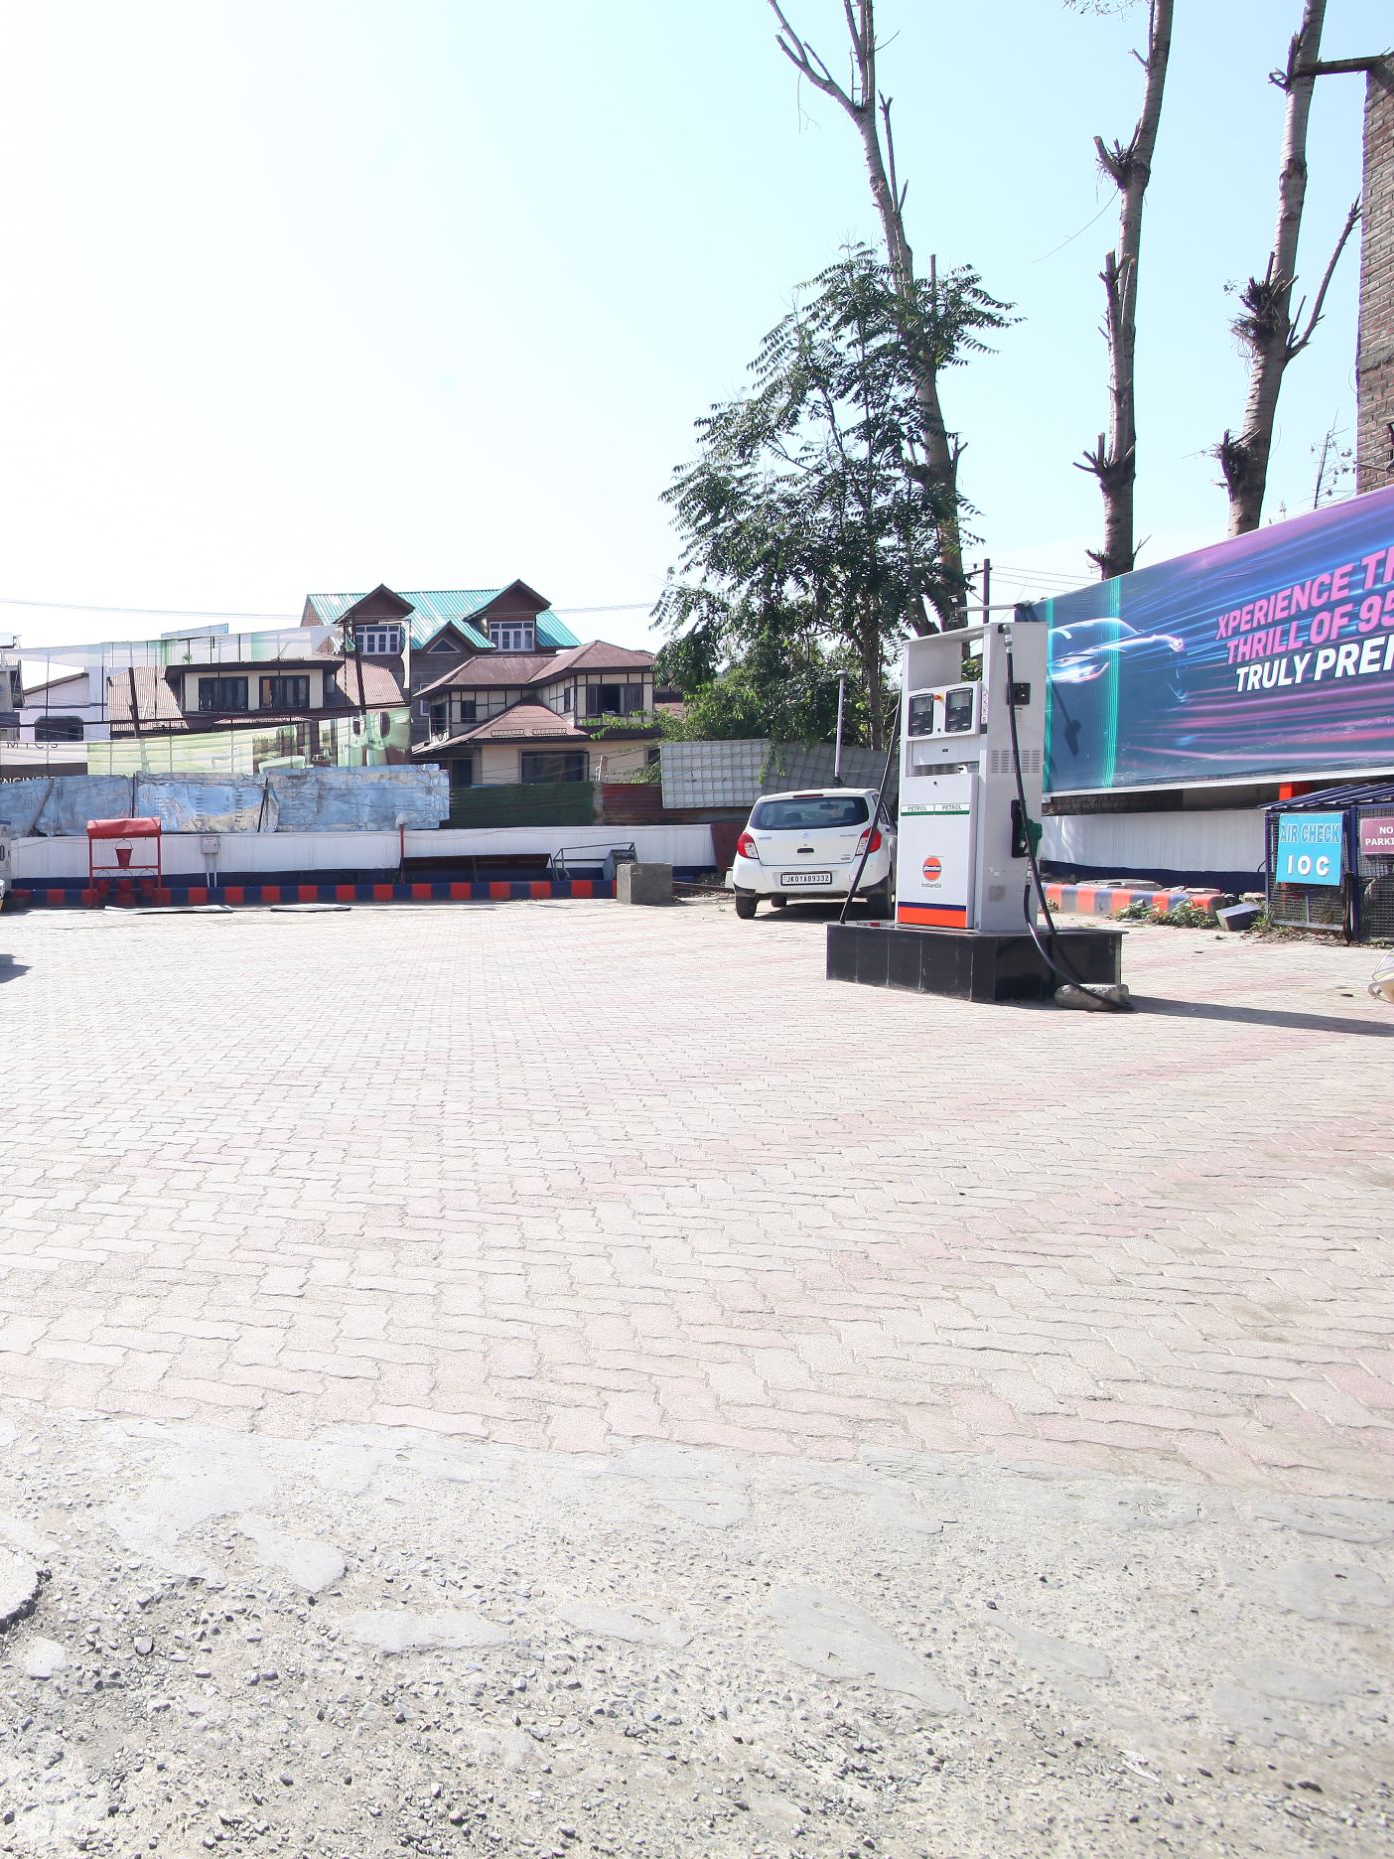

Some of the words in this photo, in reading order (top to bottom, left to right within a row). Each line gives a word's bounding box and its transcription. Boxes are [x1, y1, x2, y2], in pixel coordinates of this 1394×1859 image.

[1215, 563, 1354, 641] XPERIENCE
[1226, 620, 1304, 665] THRILL
[1309, 603, 1354, 645] OF
[1236, 652, 1312, 693] TRULY
[1279, 823, 1298, 843] AIR
[1301, 823, 1342, 844] CHECK
[1379, 826, 1393, 834] NO
[1287, 855, 1330, 876] IOC
